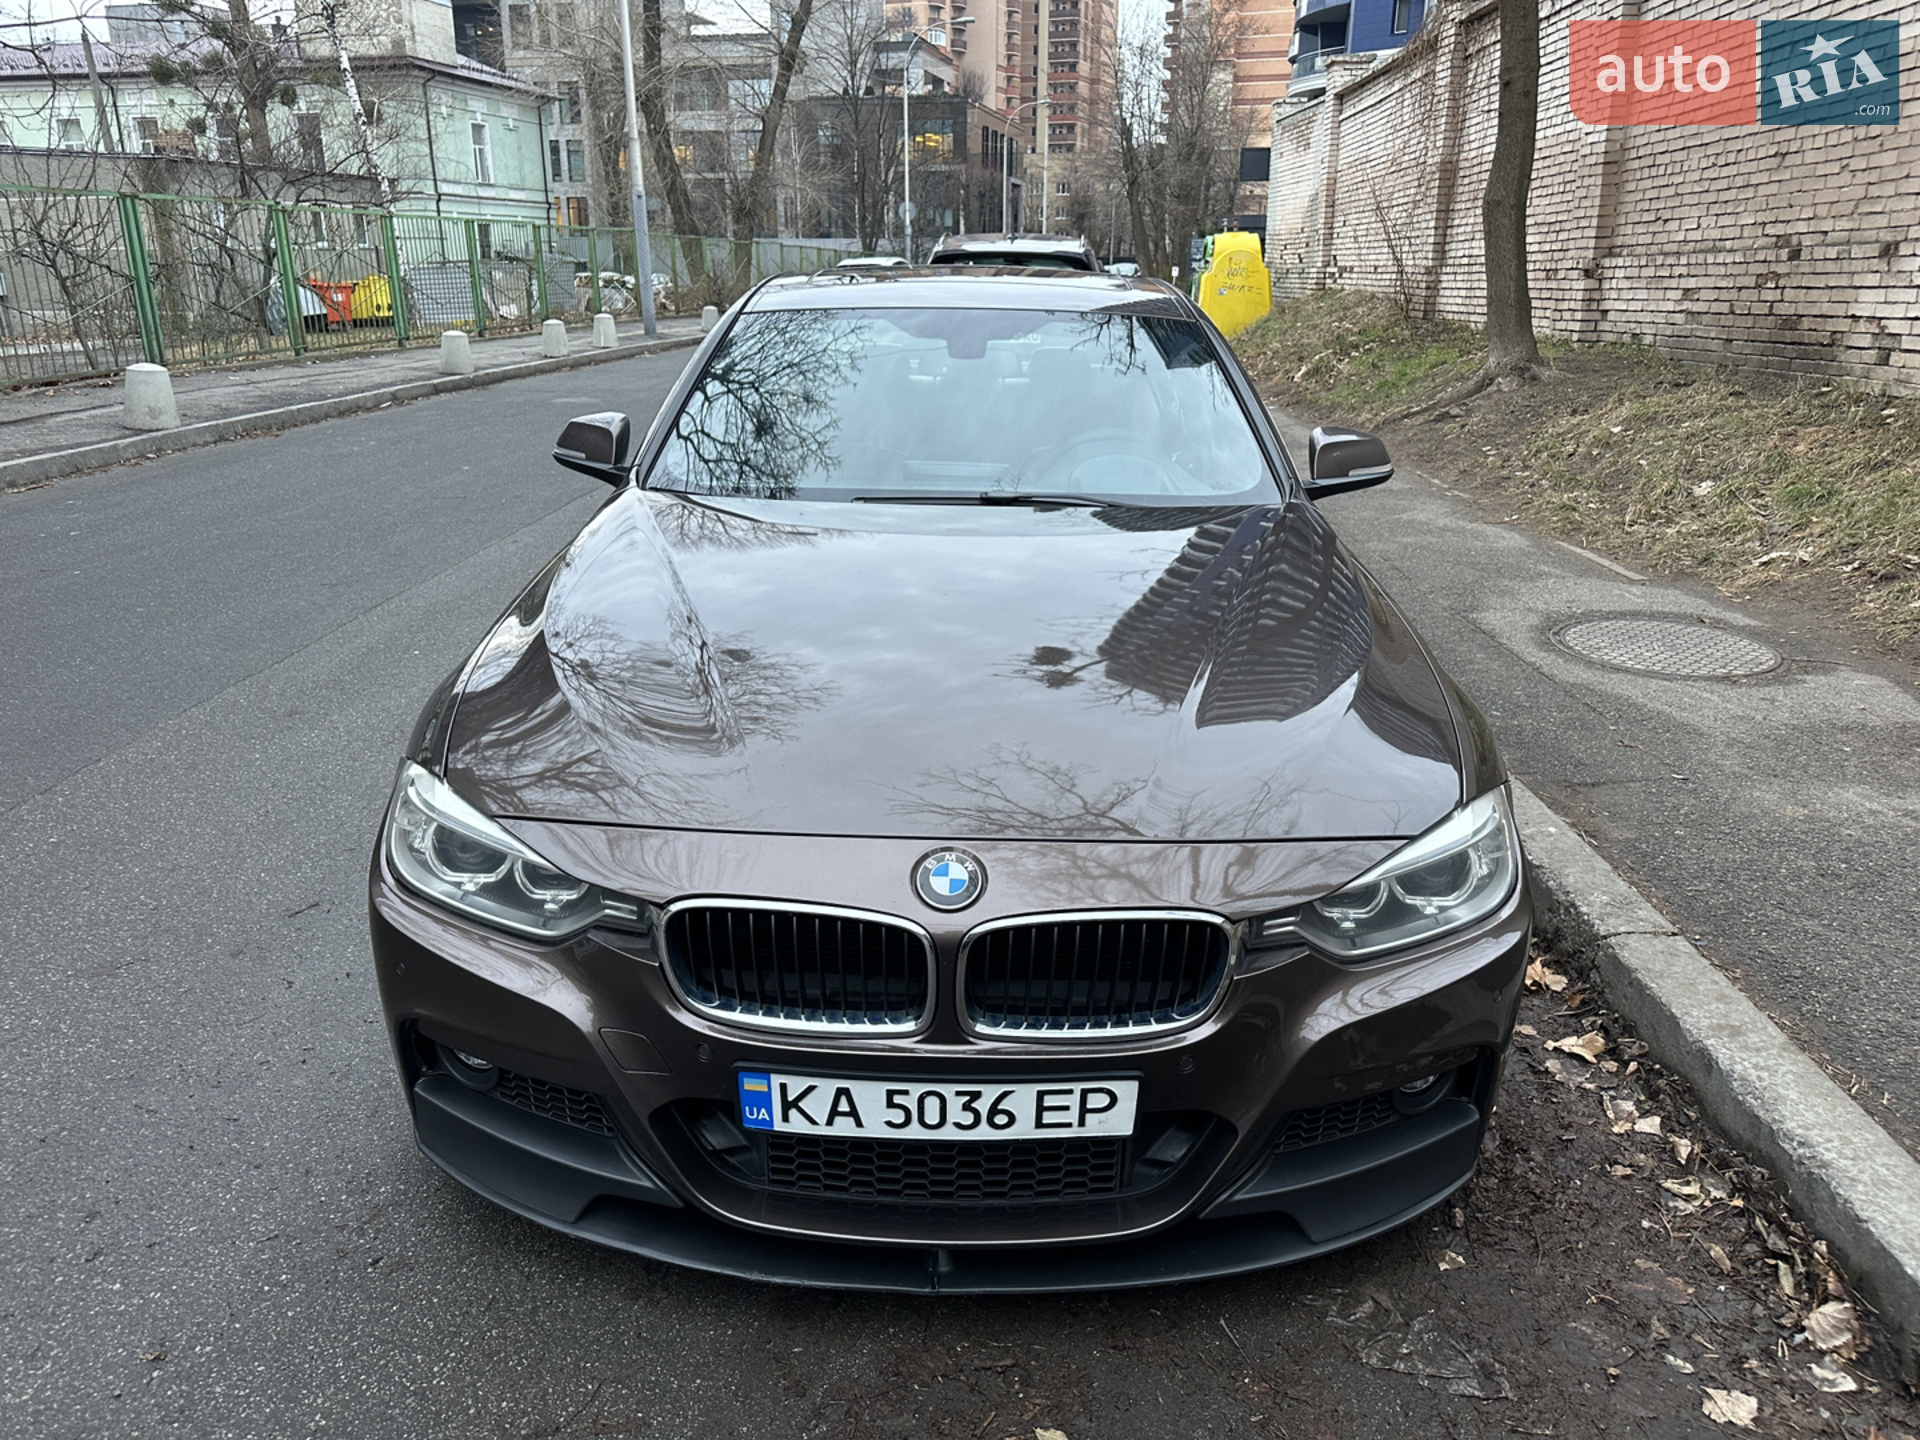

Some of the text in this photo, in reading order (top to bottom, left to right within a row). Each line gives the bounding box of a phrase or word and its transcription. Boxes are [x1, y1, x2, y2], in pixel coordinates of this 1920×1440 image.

[925, 853, 976, 872] BMW
[744, 1105, 770, 1121] UA
[778, 1081, 1118, 1131] KA 5036 EP
